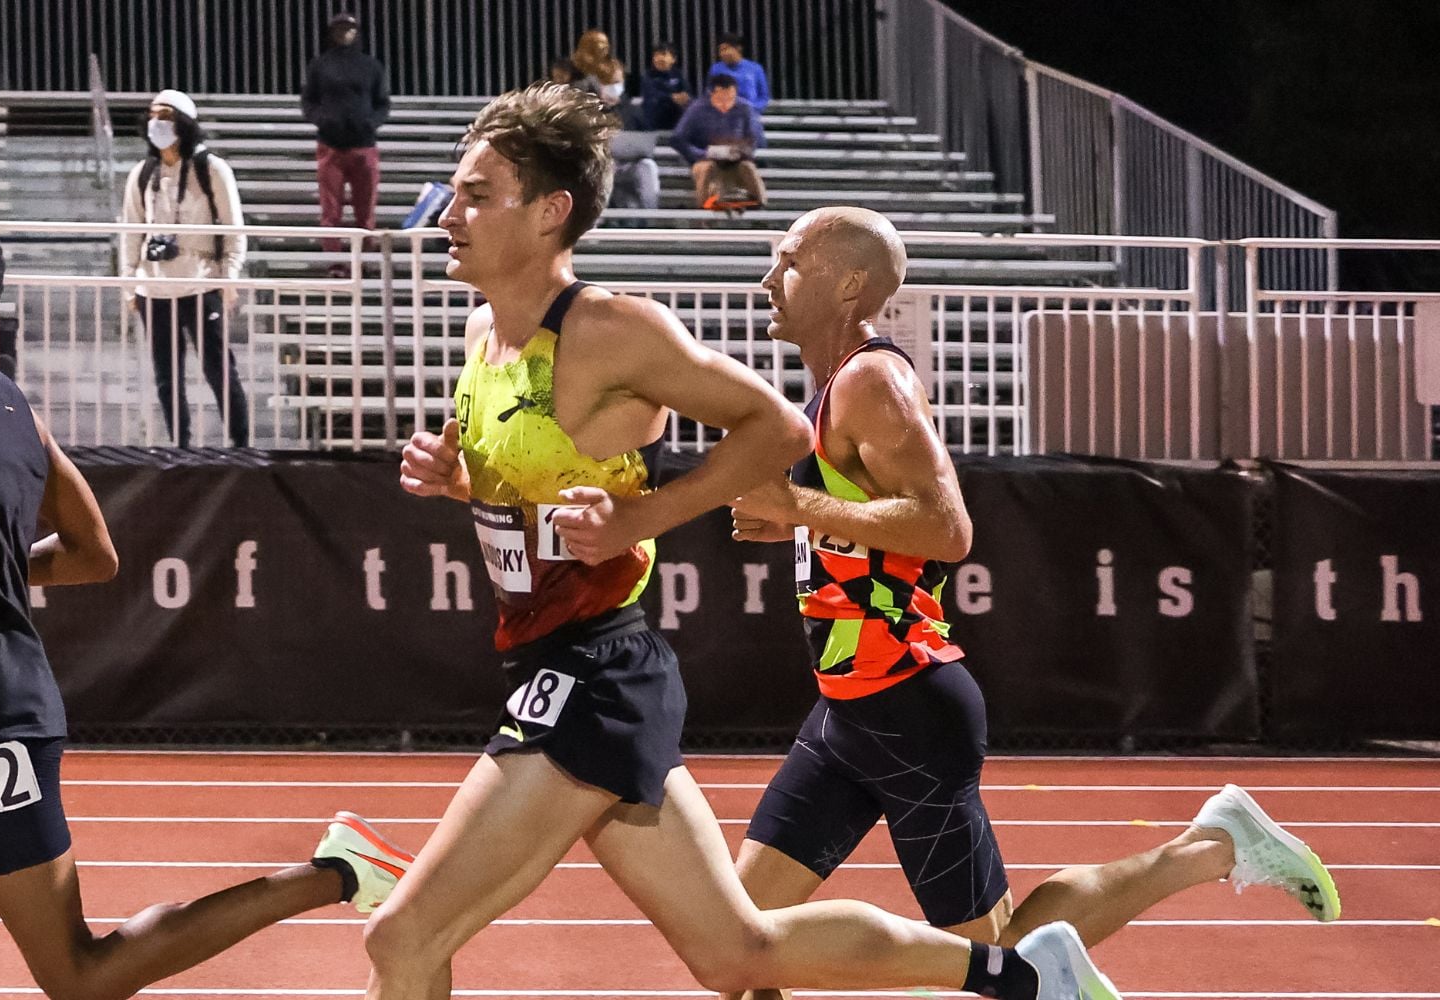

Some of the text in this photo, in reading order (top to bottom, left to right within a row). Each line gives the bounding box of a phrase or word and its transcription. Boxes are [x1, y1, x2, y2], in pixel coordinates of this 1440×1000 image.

[153, 540, 257, 608] of
[363, 543, 473, 610] th
[658, 562, 992, 629] pre
[1096, 549, 1194, 617] is
[517, 672, 560, 719] 18
